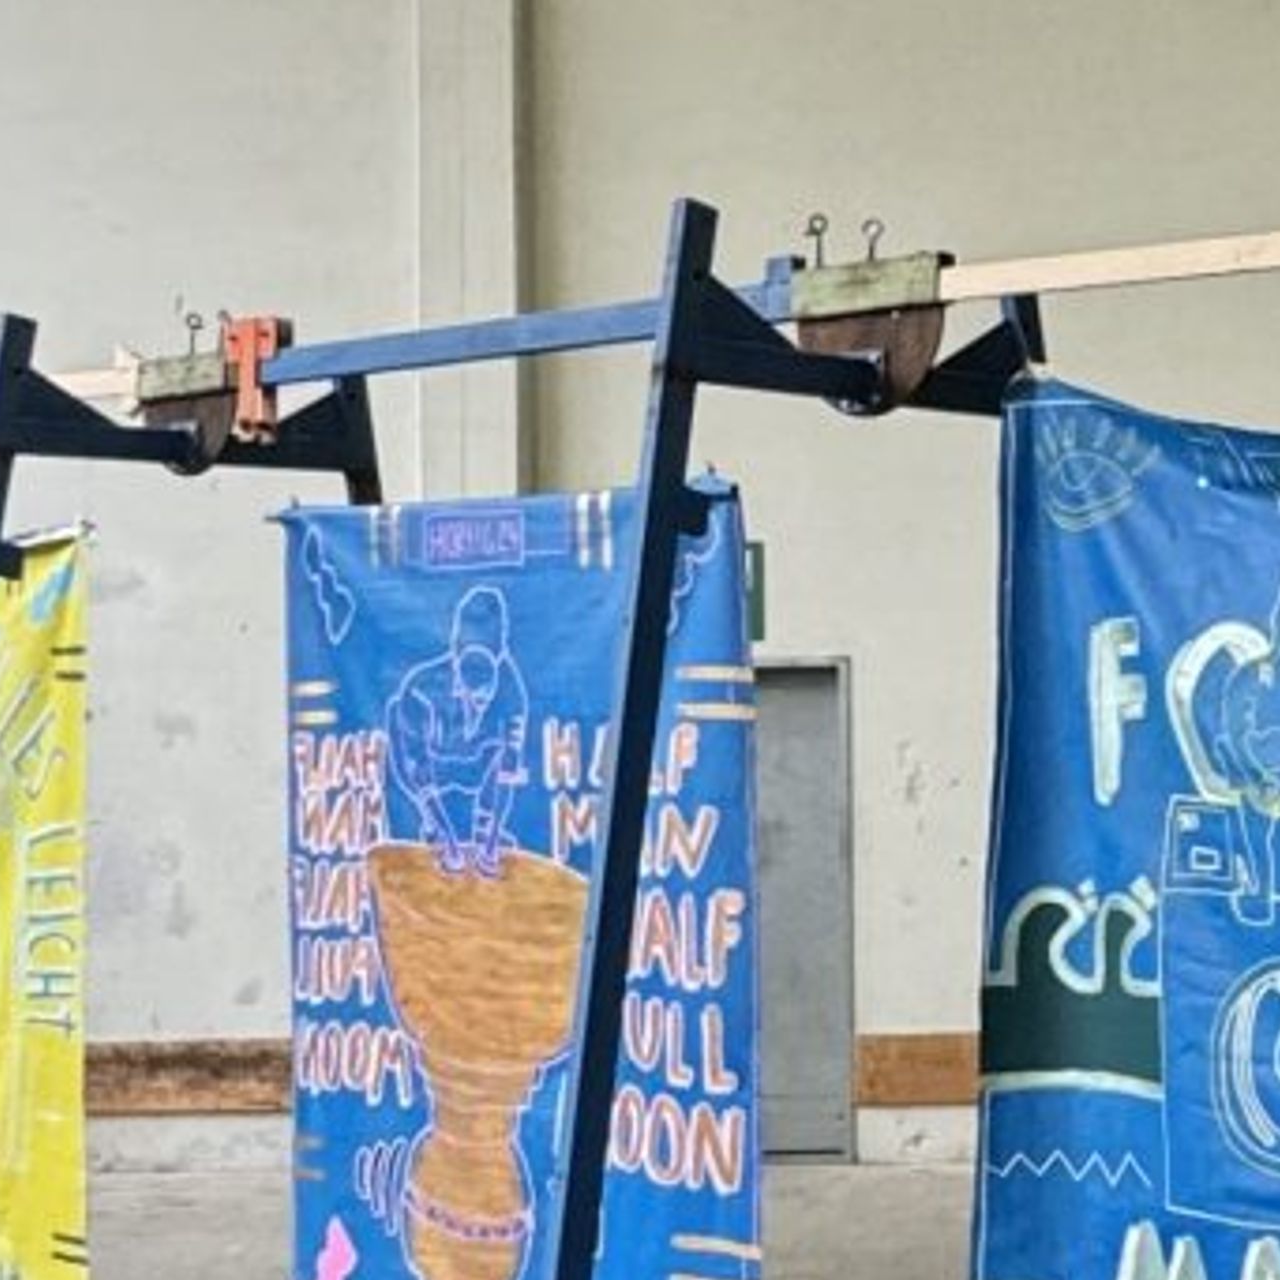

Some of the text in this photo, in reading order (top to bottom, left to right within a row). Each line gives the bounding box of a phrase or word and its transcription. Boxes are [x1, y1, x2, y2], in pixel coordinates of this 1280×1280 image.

[551, 787, 720, 878] MN
[24, 821, 79, 1040] LEICHT
[626, 886, 746, 992] ALF
[622, 990, 740, 1095] ULL
[606, 1082, 746, 1195] OON
